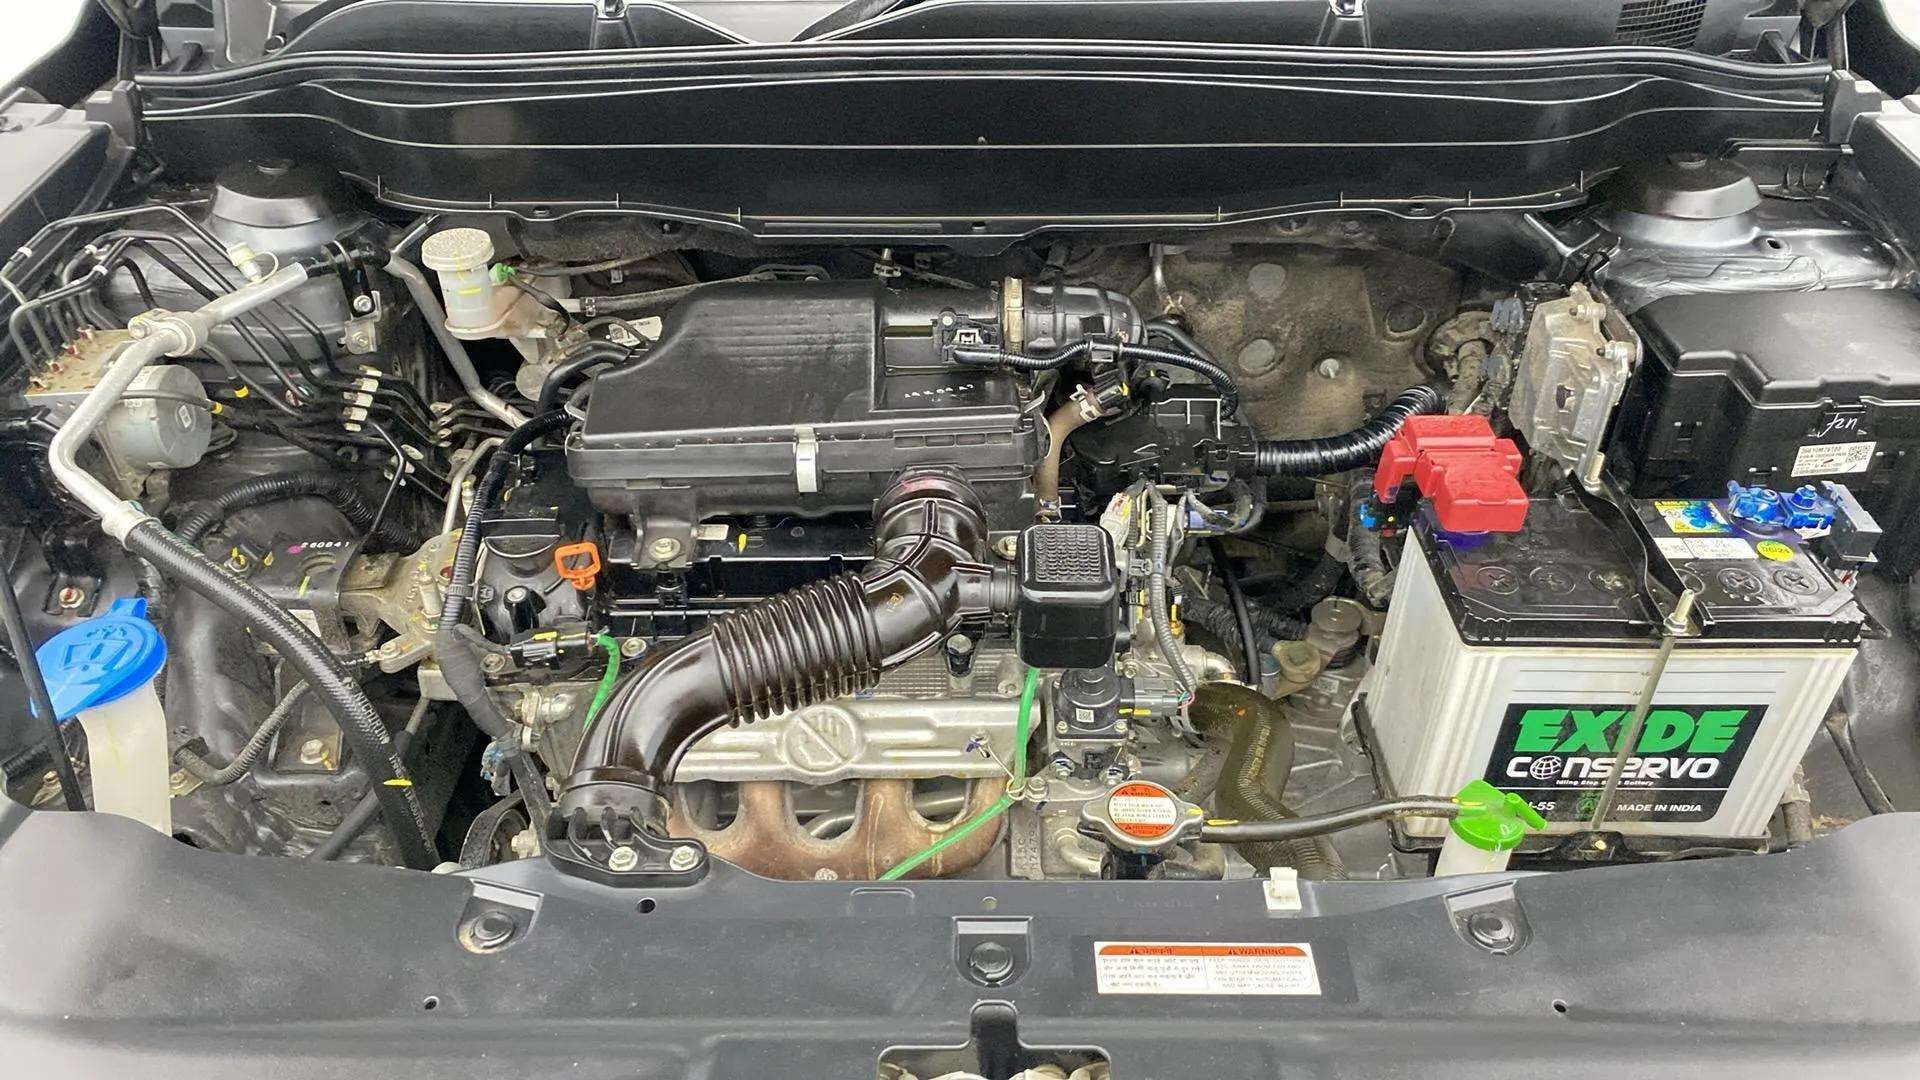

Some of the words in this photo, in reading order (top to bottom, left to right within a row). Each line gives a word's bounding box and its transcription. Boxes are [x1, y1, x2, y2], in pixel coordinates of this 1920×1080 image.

[1514, 709, 1749, 753] EXIDE
[1528, 801, 1556, 811] -55
[1617, 804, 1653, 812] MADE
[1655, 804, 1668, 812] IN
[1670, 804, 1702, 812] INDIA
